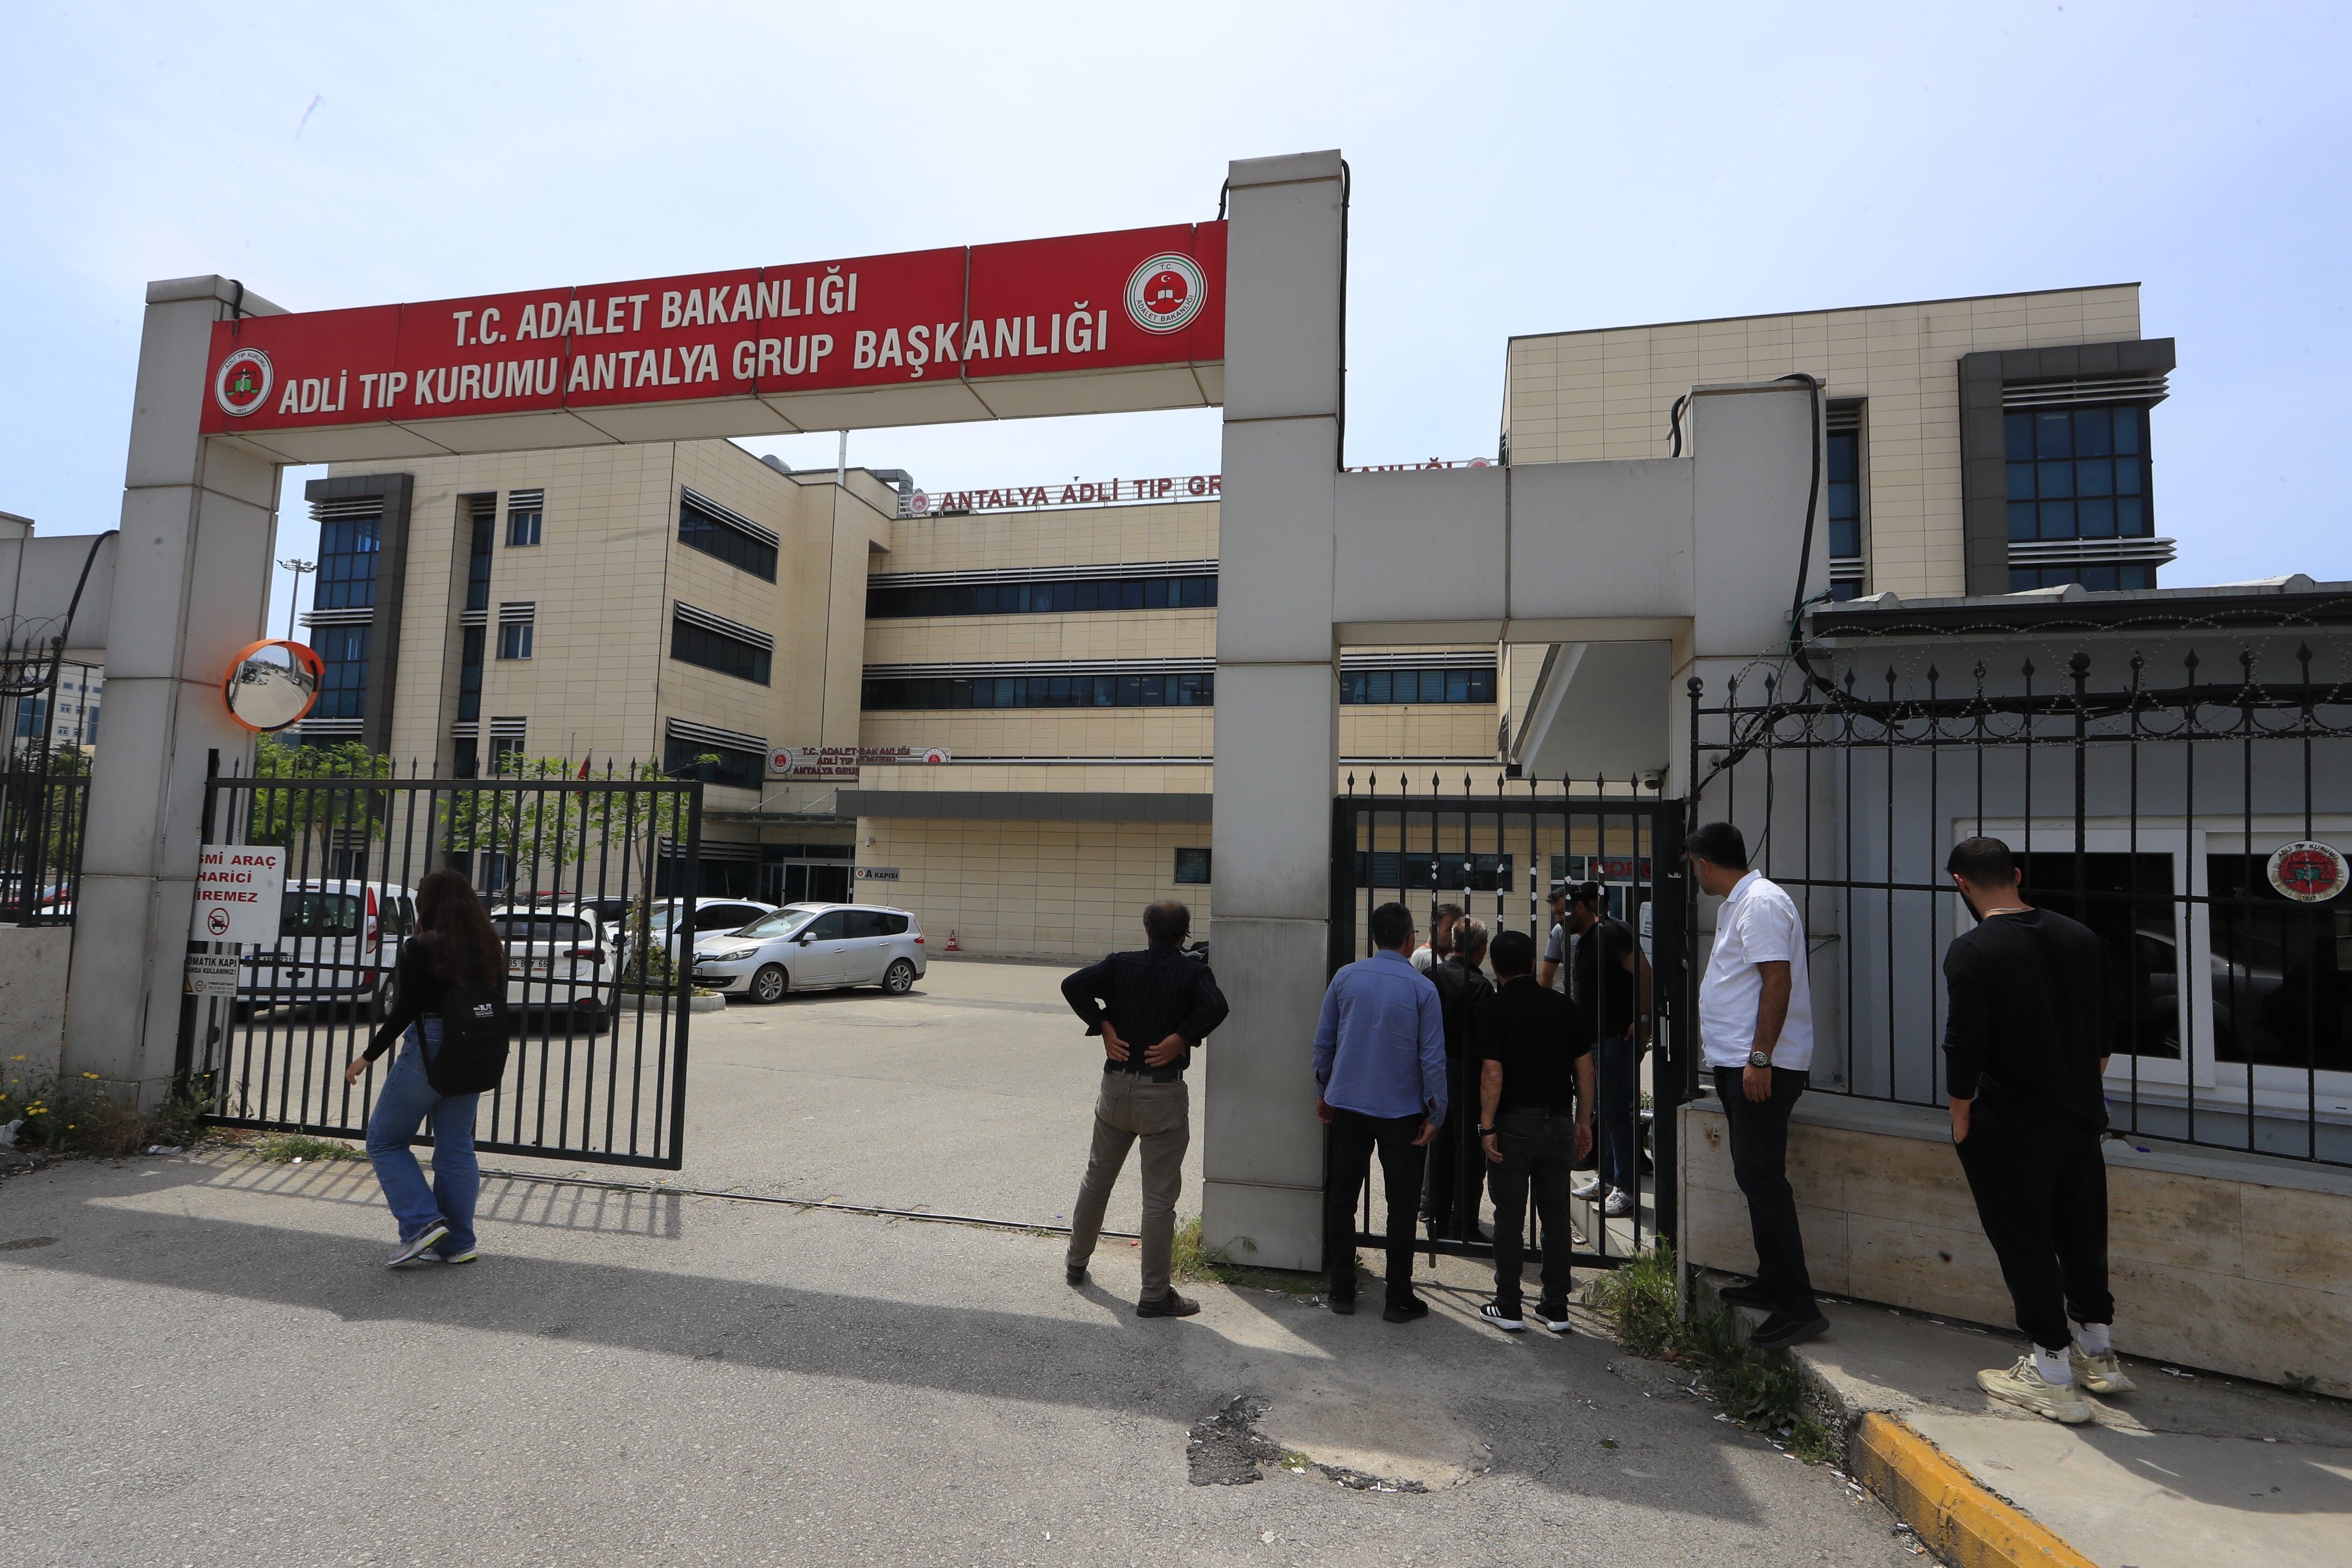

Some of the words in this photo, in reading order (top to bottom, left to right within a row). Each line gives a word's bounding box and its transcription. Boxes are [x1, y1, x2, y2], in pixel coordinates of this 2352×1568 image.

[452, 307, 506, 347] T.C.
[516, 293, 650, 341] ADALET
[661, 265, 857, 328] BAKANLIĞI
[1137, 299, 1158, 320] ADALET
[1160, 295, 1194, 322] BAKANLIĞI
[247, 353, 267, 368] KURUMU
[278, 369, 348, 415] ADLİ
[360, 372, 409, 409] TIP
[414, 356, 559, 407] KURUMU
[566, 344, 720, 393] ANTALYA
[732, 333, 834, 380] GRUP
[853, 300, 1109, 378] BAŞKANLIĞI
[941, 485, 1049, 510] ANTALYA
[1060, 478, 1119, 503] ADLİ
[1132, 478, 1173, 499] TIP
[1187, 474, 1222, 495] GR
[802, 747, 818, 755] T.C.
[820, 747, 856, 755] ADALET
[817, 755, 838, 765] ADLİ
[839, 757, 853, 765] TIP
[793, 766, 834, 775] ANTALYA
[2309, 844, 2339, 860] KURUMU
[199, 851, 223, 864] SMİ
[230, 855, 276, 870] ARAÇ
[197, 870, 251, 883] HARİCİ
[866, 870, 872, 878] A
[197, 888, 258, 903] İREMEZ
[188, 956, 216, 966] OMATİK
[219, 958, 237, 967] KAPI
